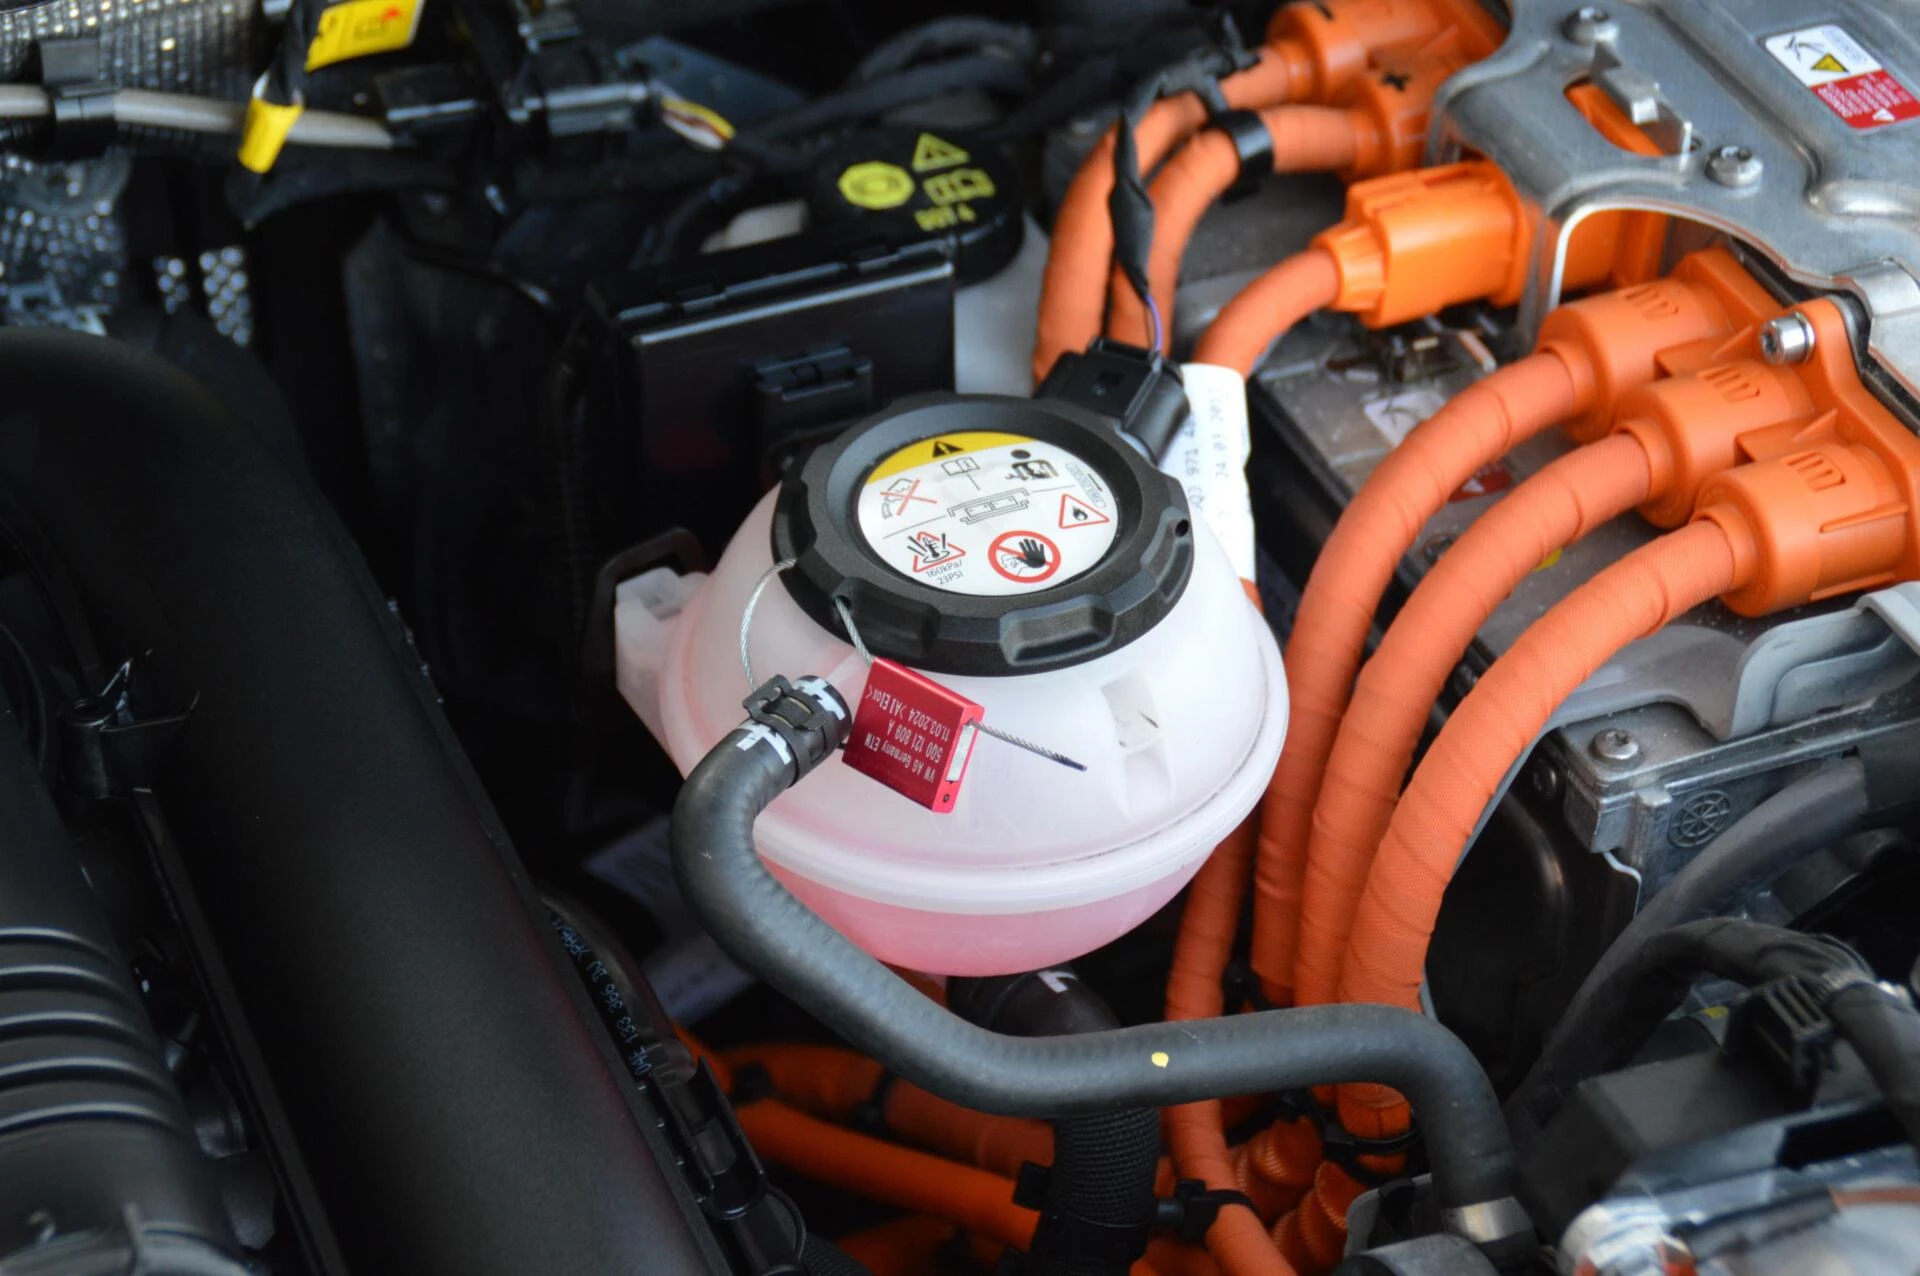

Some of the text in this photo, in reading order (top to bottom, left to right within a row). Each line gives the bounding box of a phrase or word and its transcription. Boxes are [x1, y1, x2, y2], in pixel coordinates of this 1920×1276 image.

[937, 570, 964, 585] 23PSI
[887, 719, 896, 735] A
[895, 724, 912, 745] 809
[908, 708, 950, 742] 11.03.2024
[911, 735, 926, 753] 121
[882, 740, 911, 769] Germany
[912, 759, 925, 776] AG
[924, 767, 936, 784] VW
[600, 983, 623, 1013] 366
[616, 1016, 639, 1043] 133
